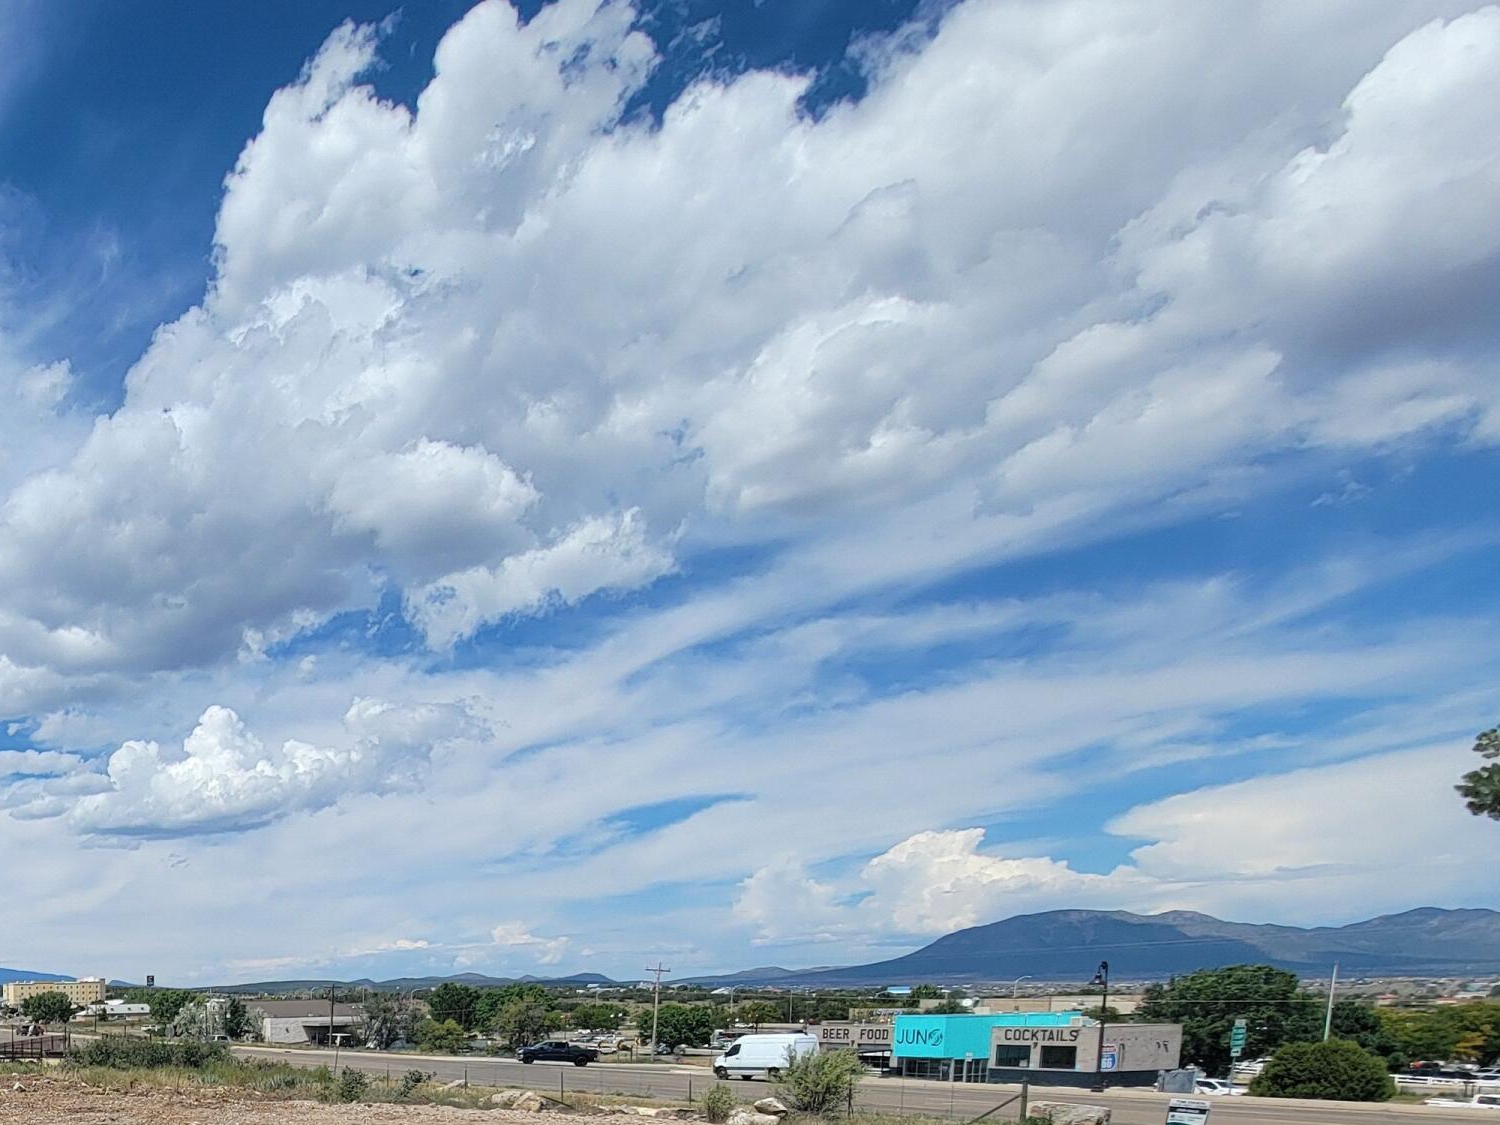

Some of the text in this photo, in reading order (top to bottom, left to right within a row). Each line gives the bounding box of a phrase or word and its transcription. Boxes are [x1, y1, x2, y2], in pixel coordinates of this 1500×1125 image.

[822, 1028, 889, 1040] BEER FOOD
[1004, 1029, 1079, 1042] COCKTAILS
